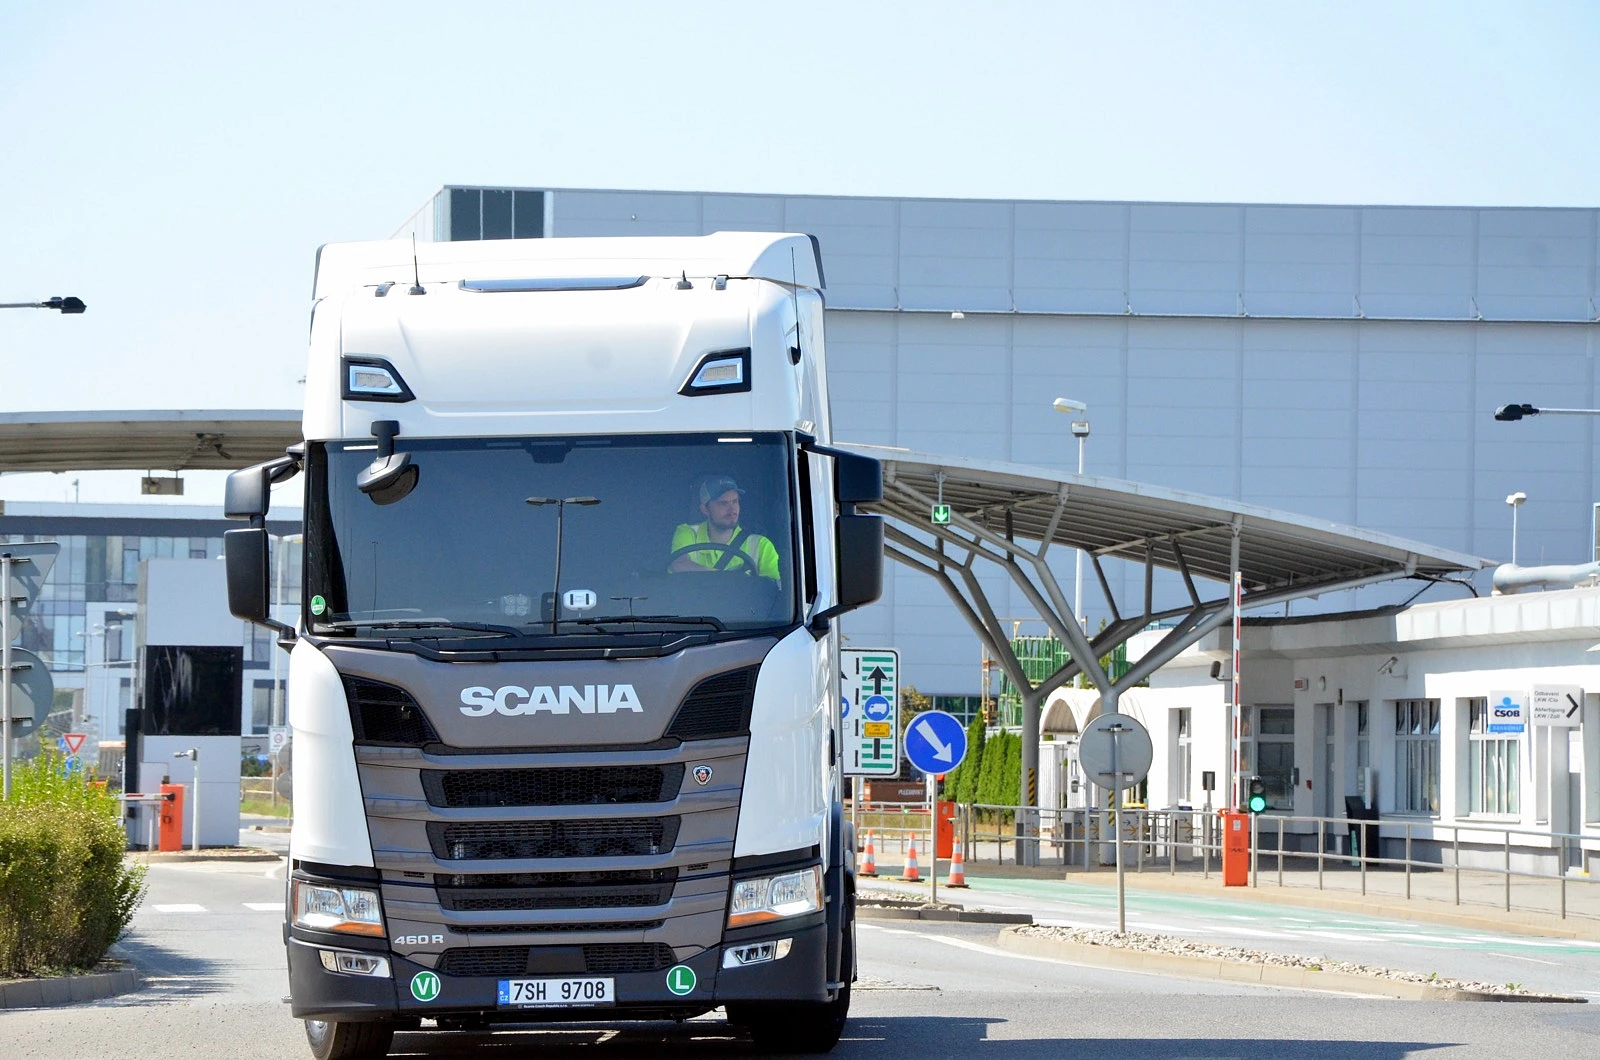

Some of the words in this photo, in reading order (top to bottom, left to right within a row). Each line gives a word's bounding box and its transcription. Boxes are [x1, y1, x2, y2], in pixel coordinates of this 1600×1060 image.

[460, 684, 644, 717] SCANIA
[1494, 709, 1520, 717] ČSOB
[394, 935, 429, 944] 460
[431, 934, 444, 944] R
[415, 977, 437, 996] VI
[675, 970, 690, 990] L
[514, 982, 547, 1000] 7SH
[561, 981, 605, 1000] 9708
